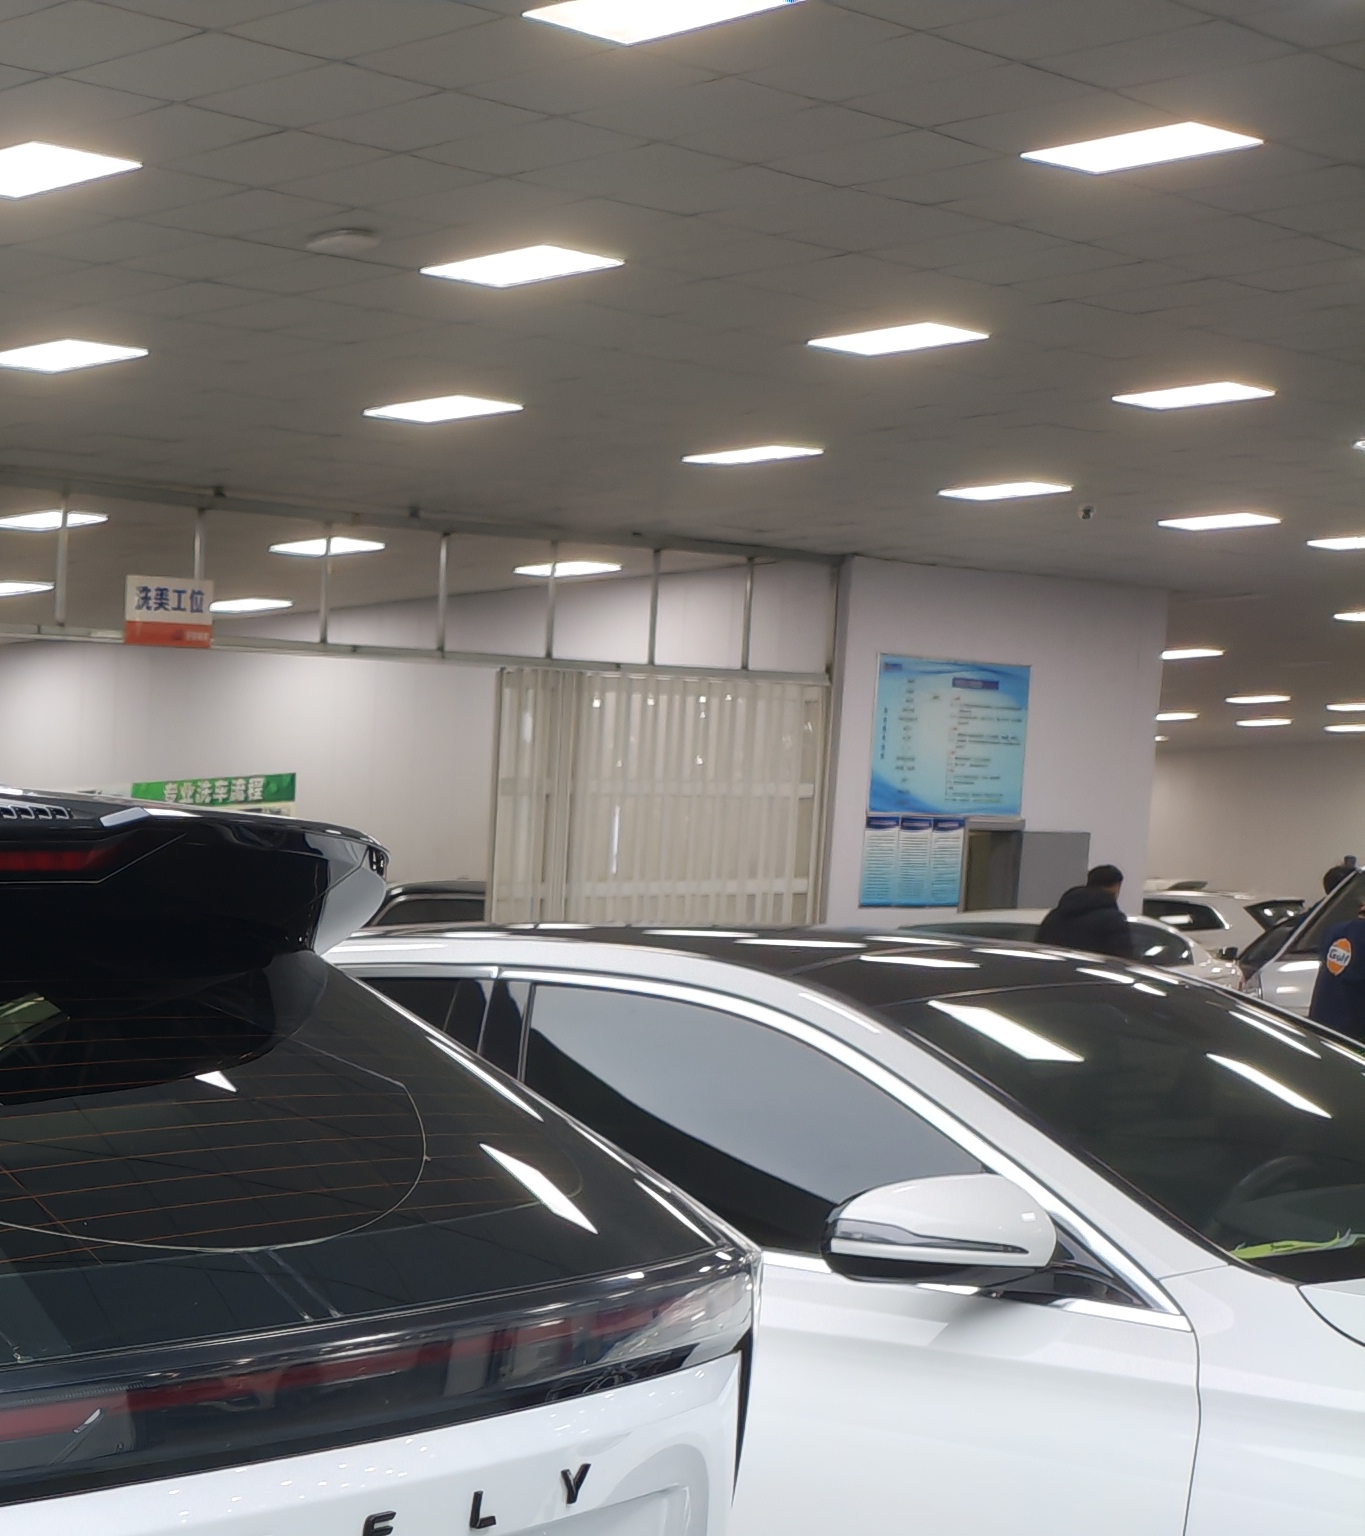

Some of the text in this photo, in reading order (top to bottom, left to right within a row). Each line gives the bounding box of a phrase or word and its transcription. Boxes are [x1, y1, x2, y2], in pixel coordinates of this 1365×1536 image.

[135, 586, 205, 613] 洗美工位
[164, 777, 265, 804] 专业洗车流程
